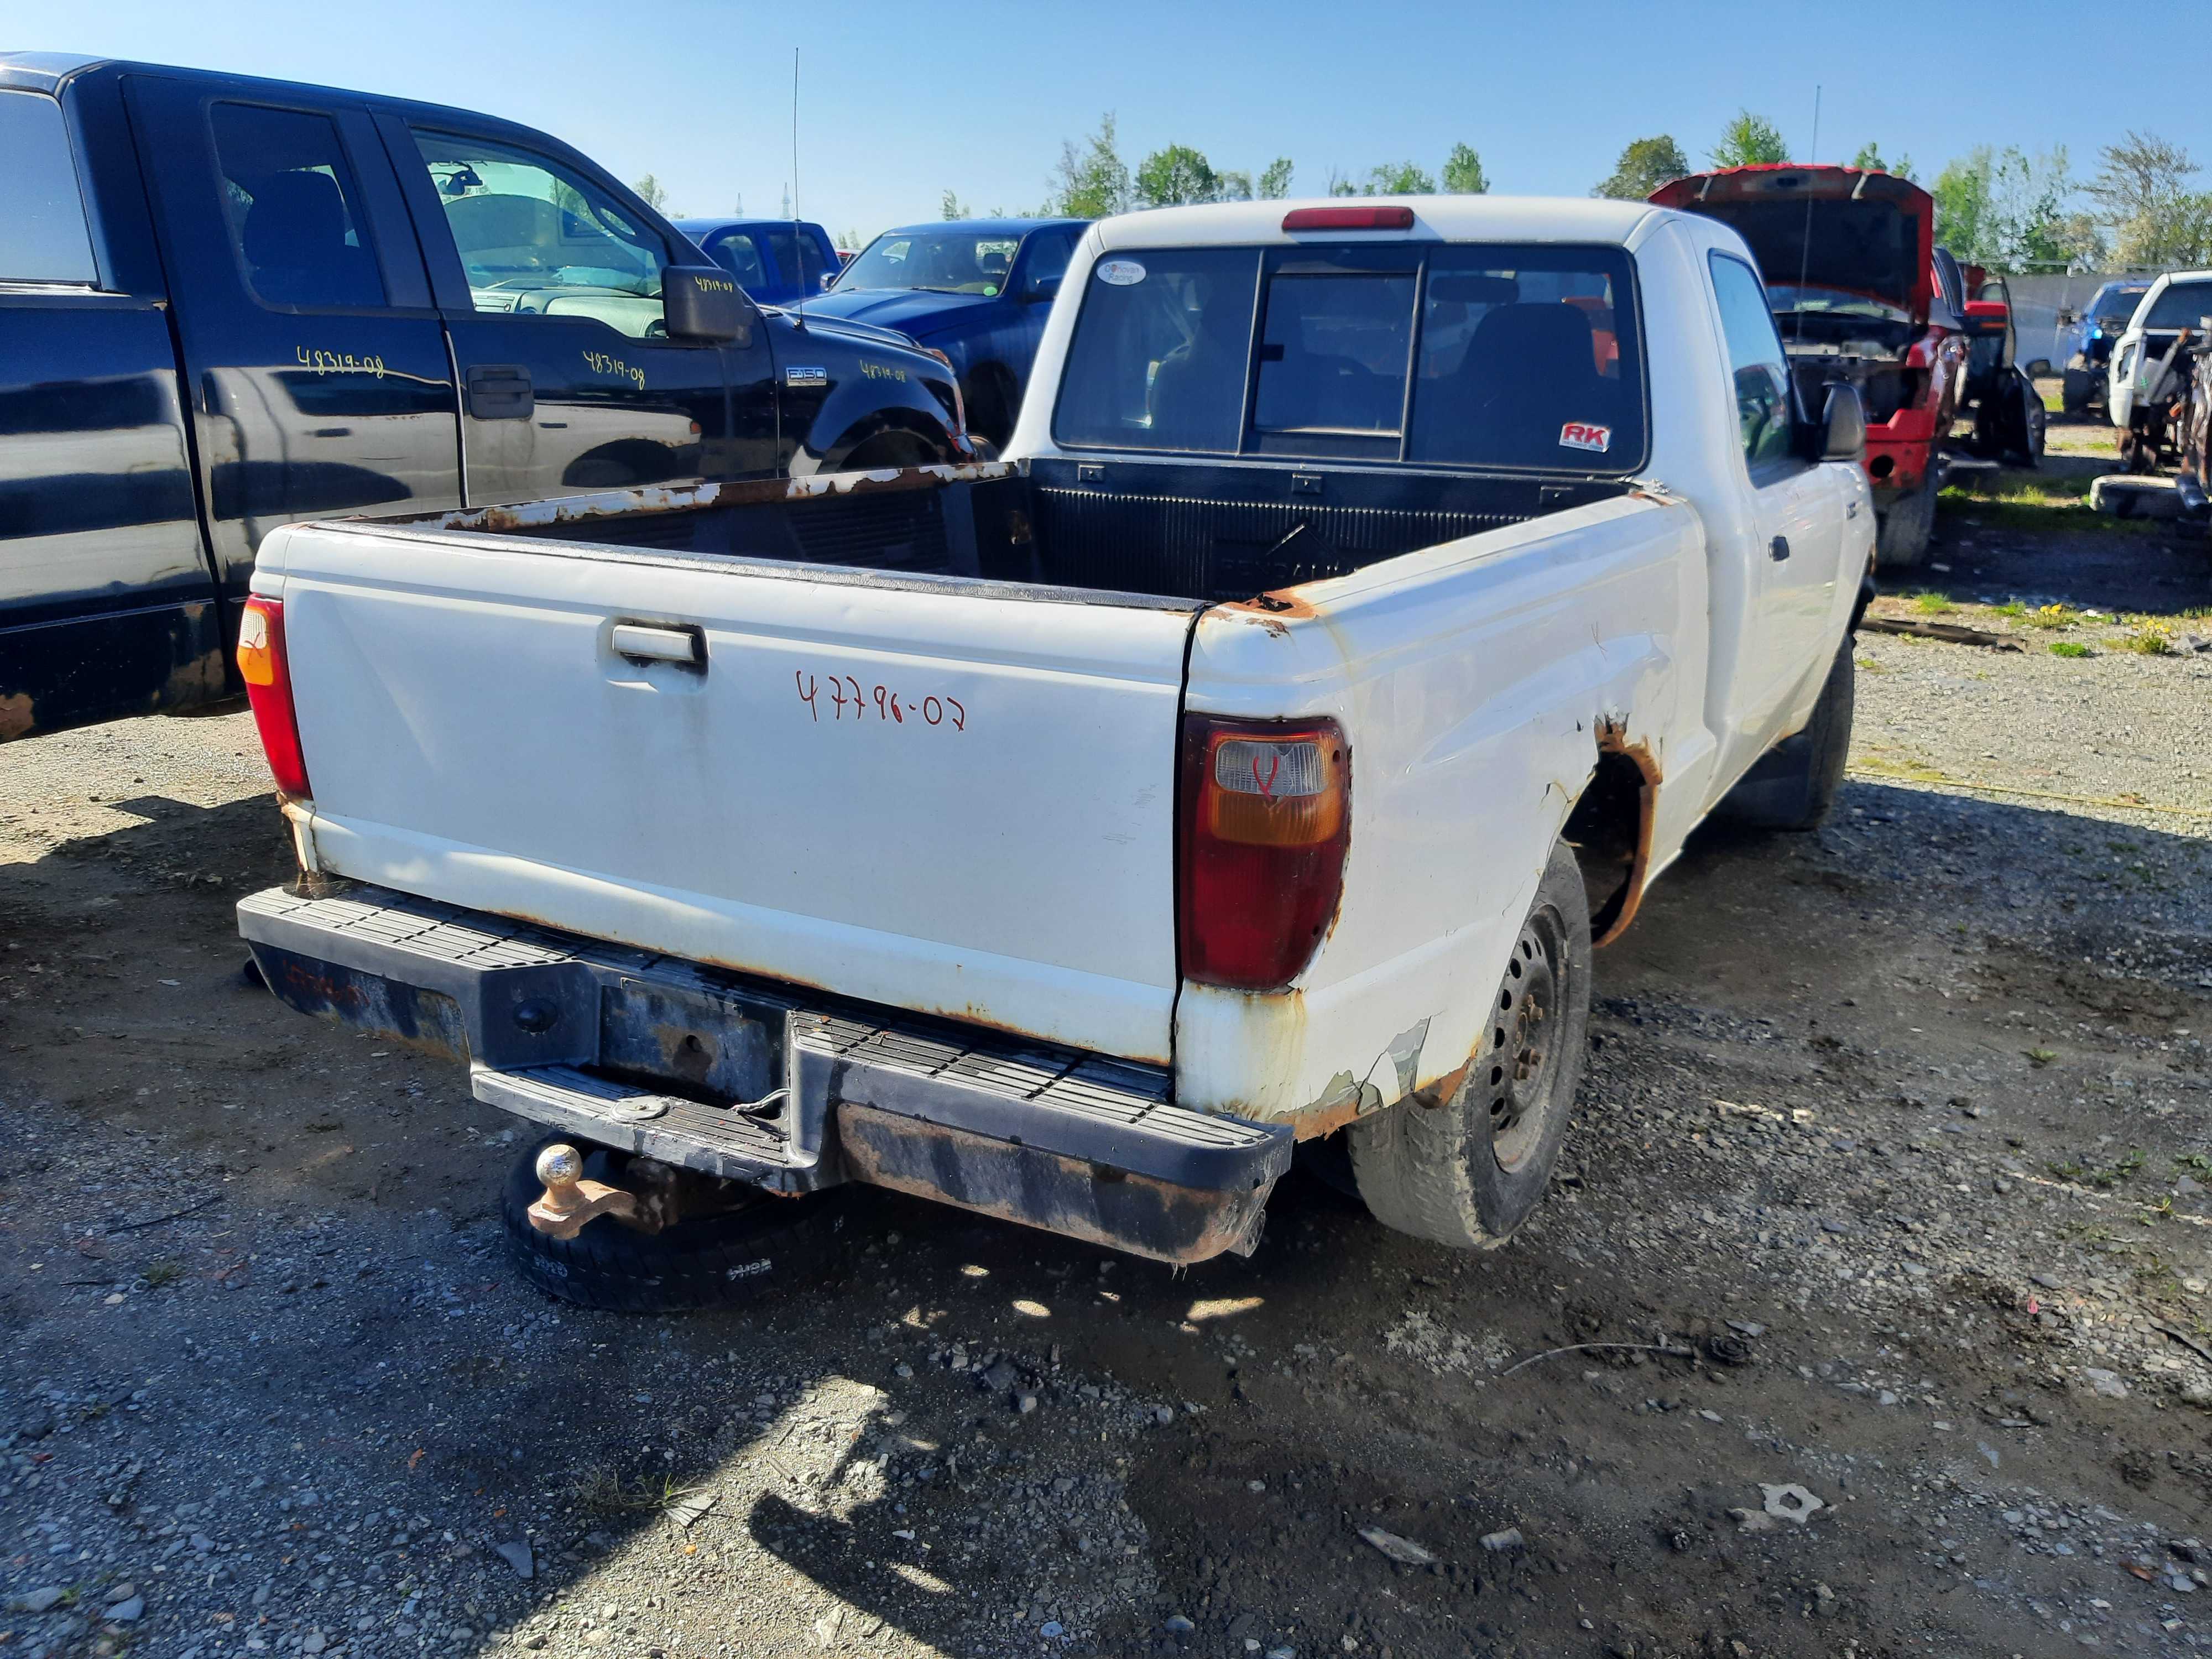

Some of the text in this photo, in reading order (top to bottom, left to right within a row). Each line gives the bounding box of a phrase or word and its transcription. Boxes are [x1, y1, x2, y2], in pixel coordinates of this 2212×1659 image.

[296, 345, 384, 379] 48319-08
[582, 350, 645, 390] 48319-08
[1563, 425, 1606, 446] RK
